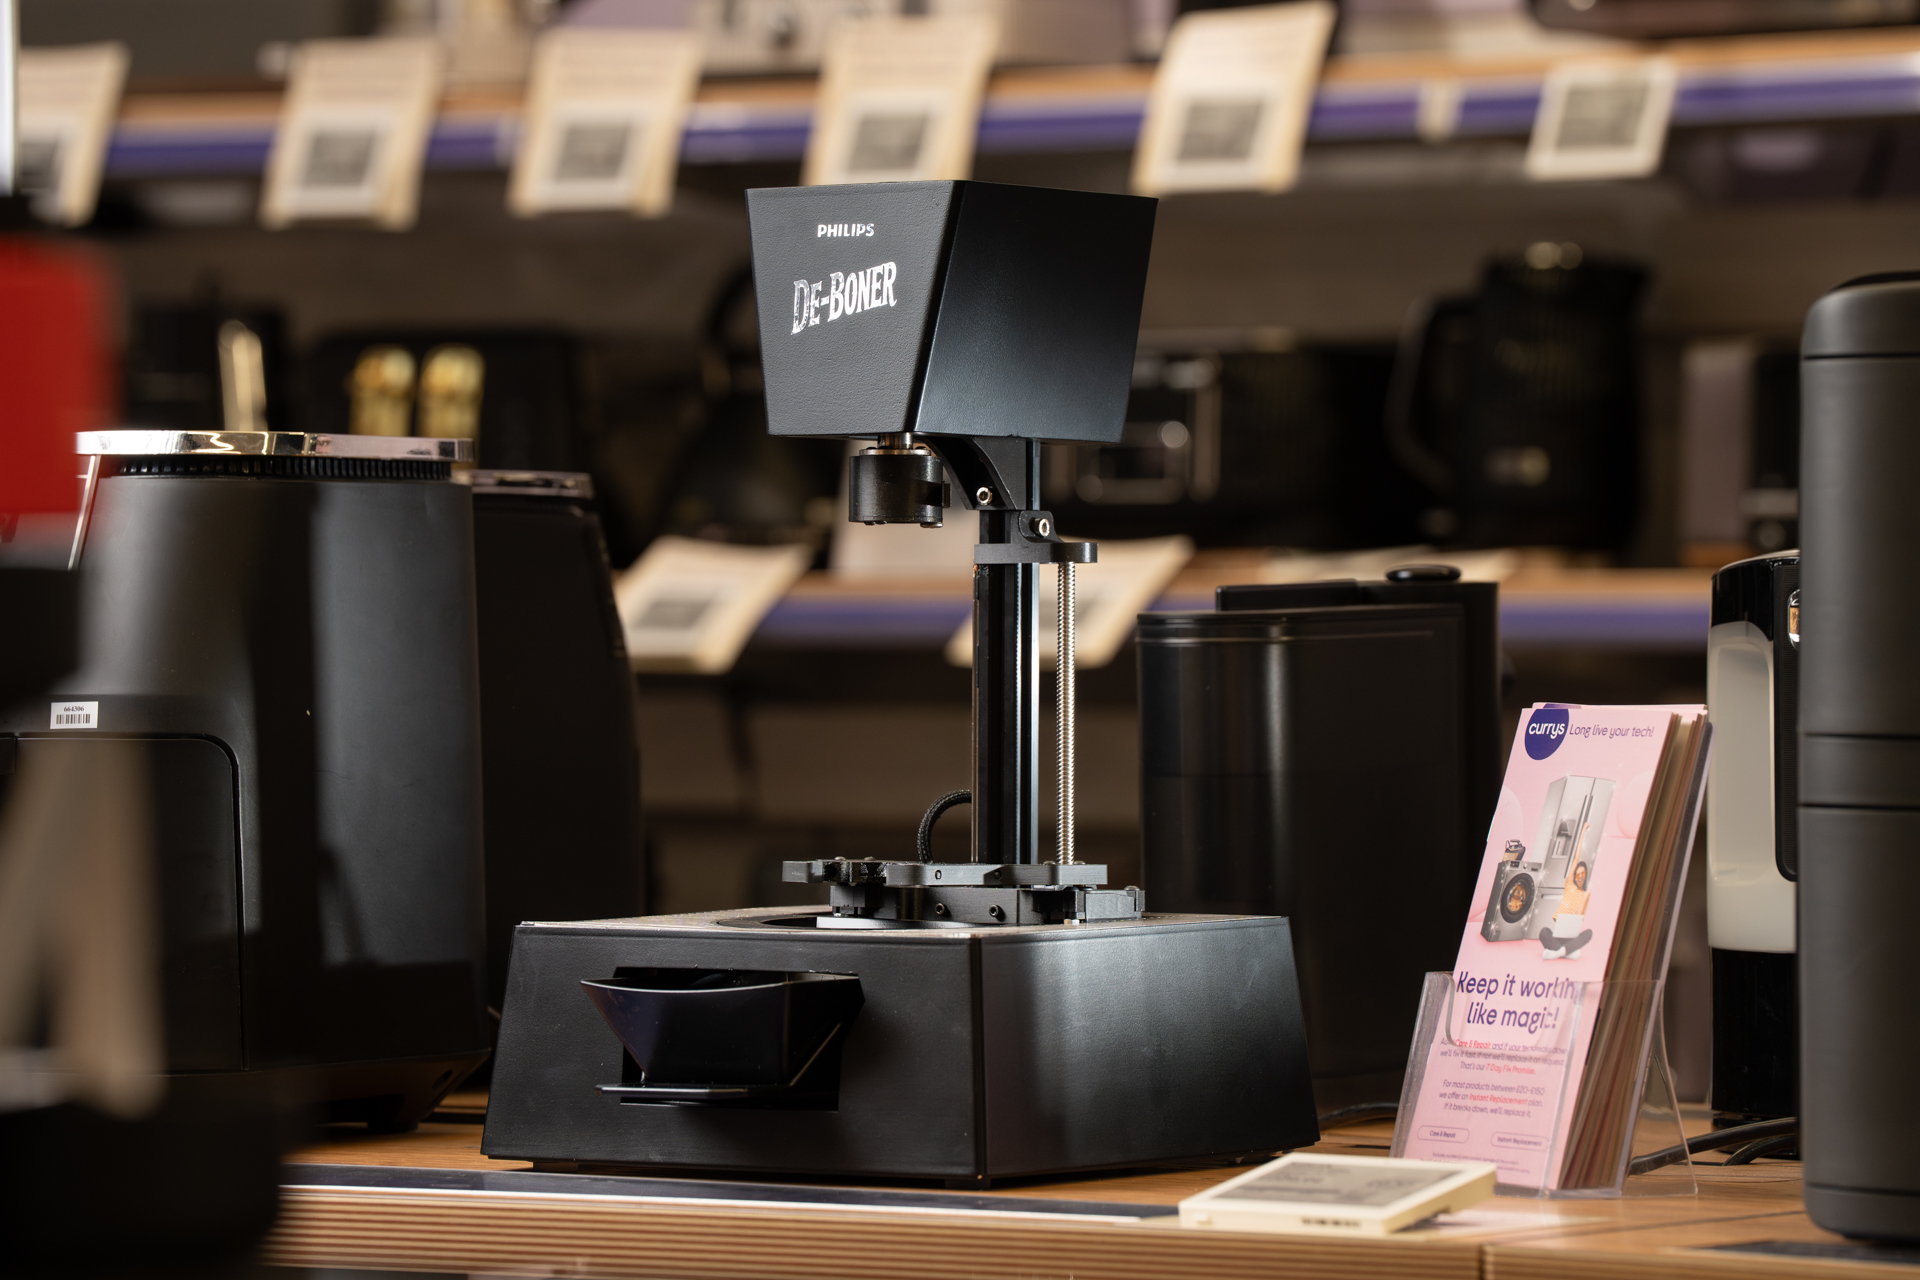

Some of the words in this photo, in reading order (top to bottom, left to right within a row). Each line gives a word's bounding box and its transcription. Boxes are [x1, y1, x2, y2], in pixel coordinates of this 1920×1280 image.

[817, 223, 875, 238] PHILIPS
[1528, 722, 1566, 740] currys
[1569, 724, 1591, 739] Long
[1592, 724, 1608, 737] live
[1608, 727, 1630, 740] your
[1631, 726, 1655, 738] tech!
[1456, 971, 1499, 1000] Keep
[1502, 973, 1516, 996] it
[1467, 1002, 1498, 1025] like
[1455, 1038, 1468, 1048] Care
[1474, 1040, 1492, 1049] Repair
[1492, 1042, 1504, 1050] and
[1490, 1063, 1502, 1074] Day
[1443, 1079, 1452, 1088] For
[1452, 1081, 1466, 1089] most
[1466, 1082, 1490, 1091] products
[1490, 1084, 1516, 1093] between
[1469, 1093, 1488, 1102] Instant
[1489, 1094, 1528, 1106] Replacement
